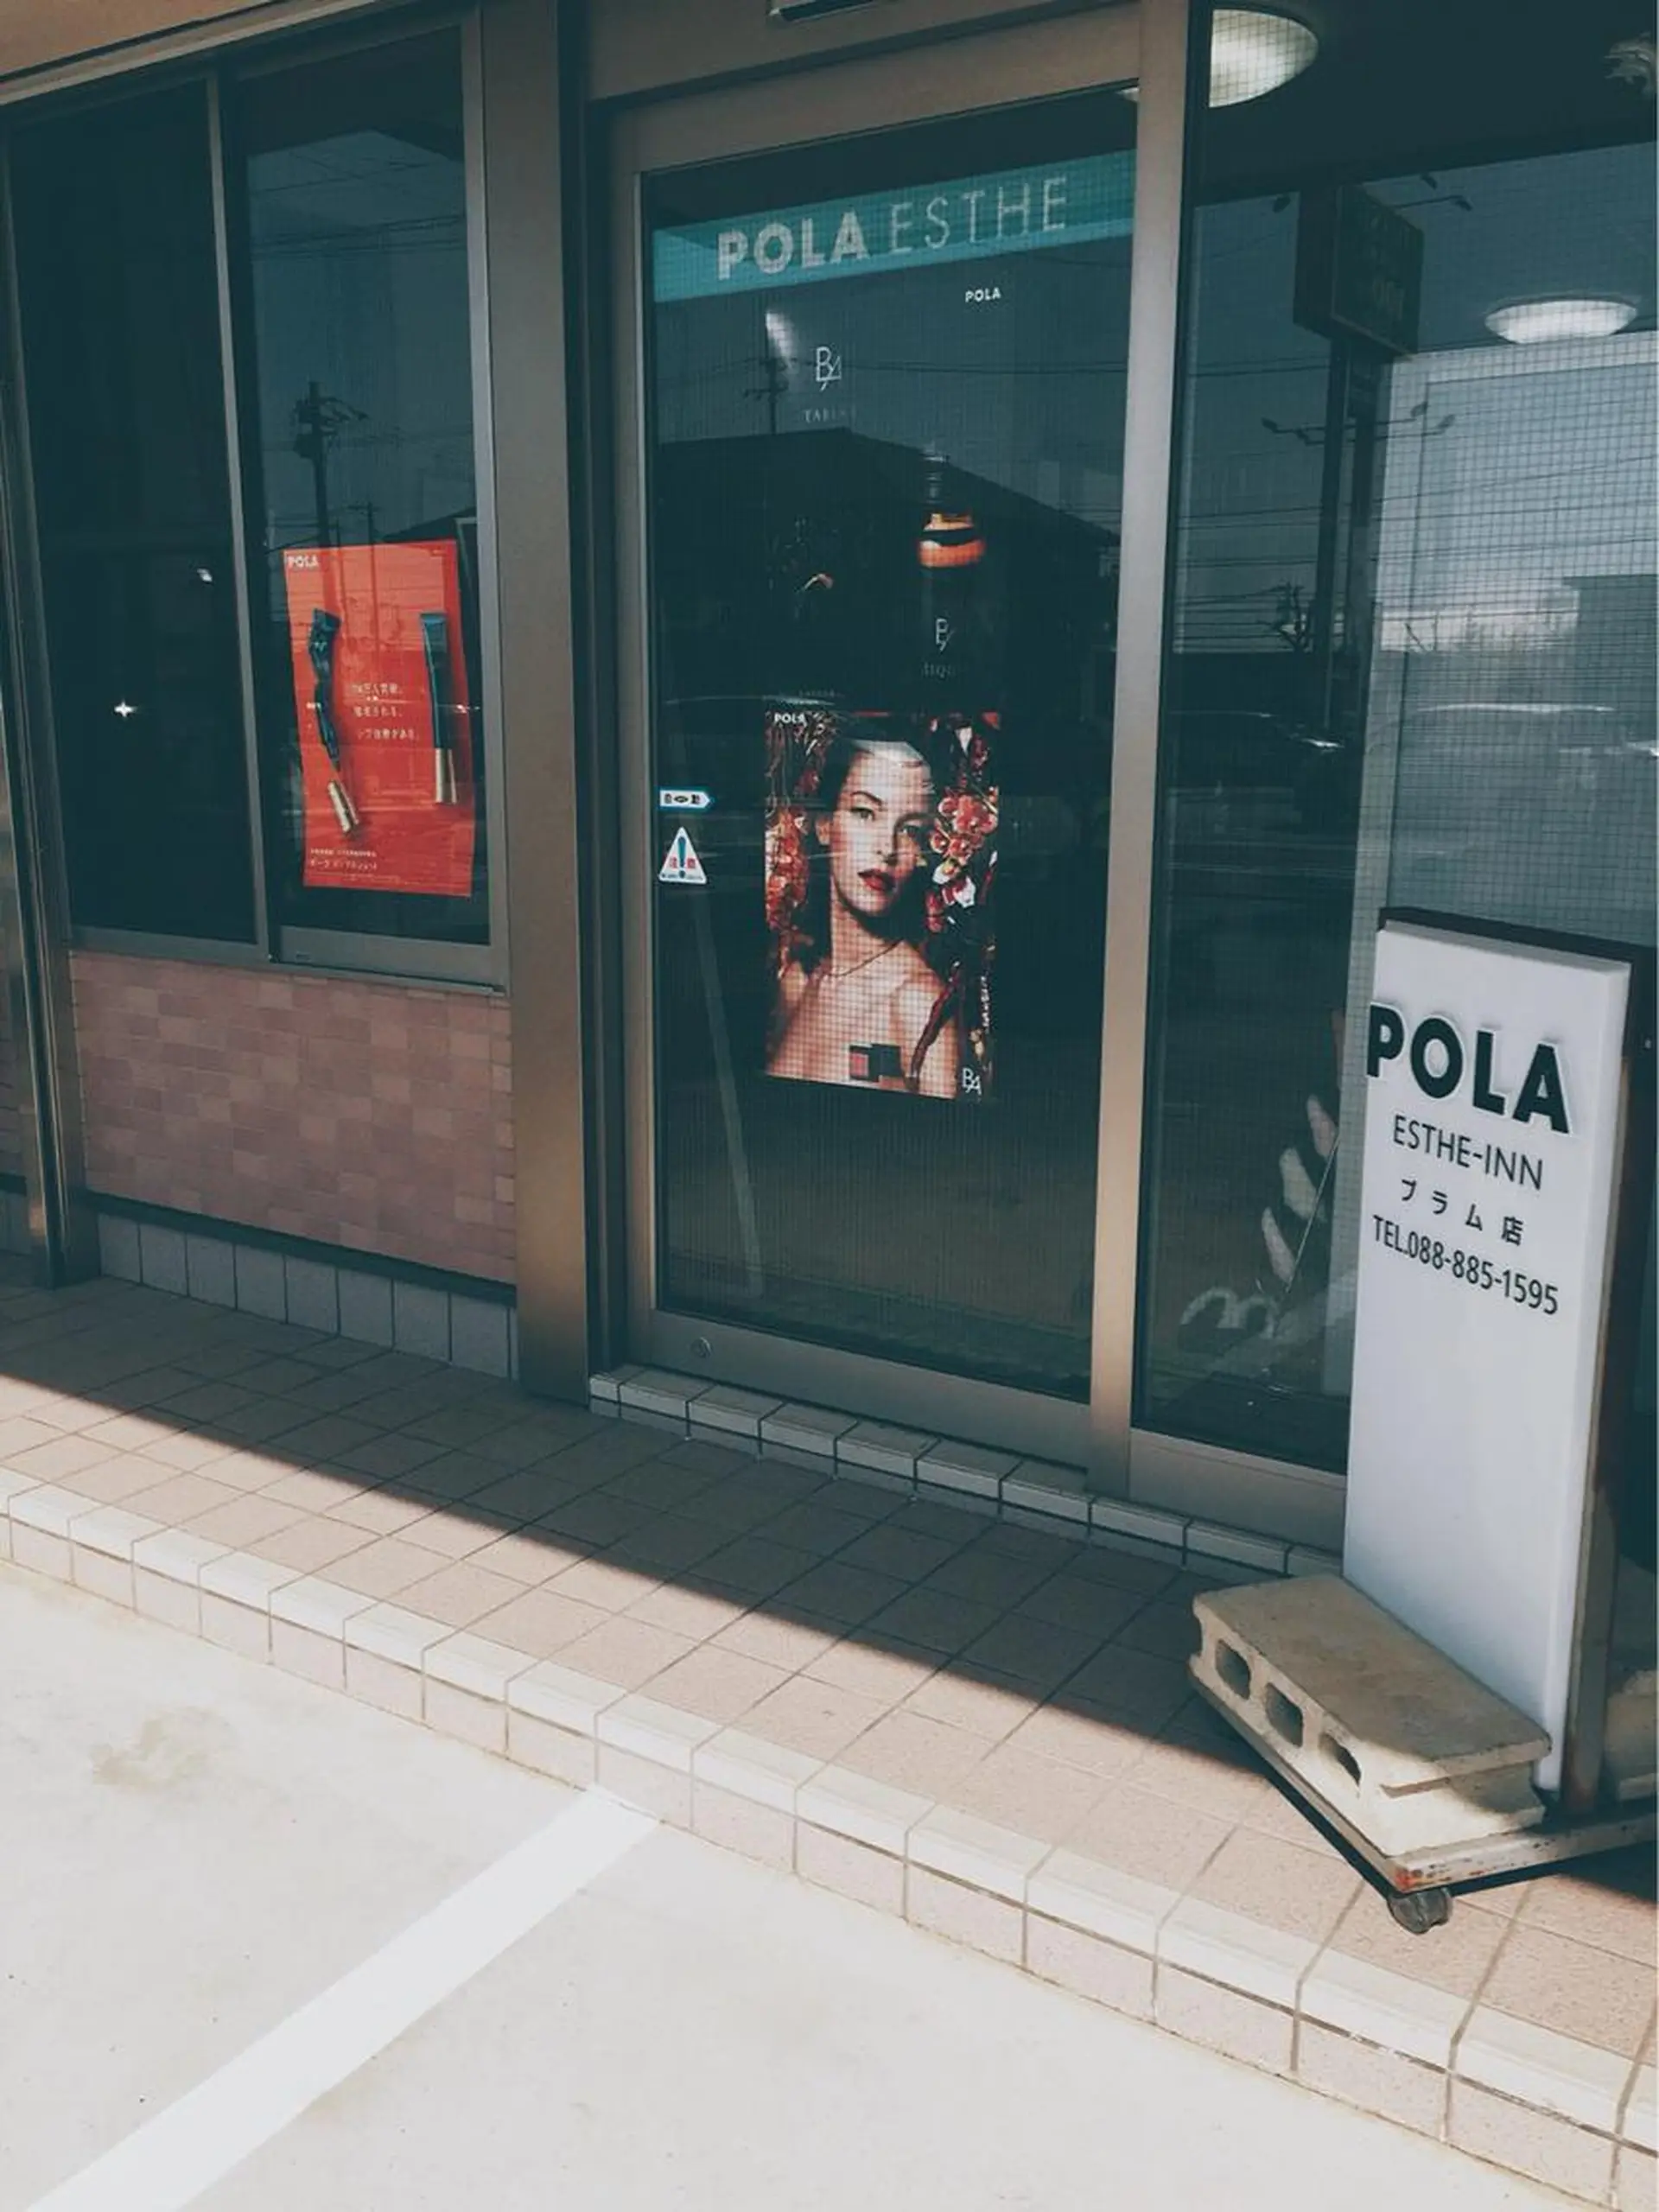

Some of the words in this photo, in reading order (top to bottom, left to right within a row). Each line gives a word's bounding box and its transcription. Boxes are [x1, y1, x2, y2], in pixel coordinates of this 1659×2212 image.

[718, 210, 869, 280] POLA
[890, 177, 1067, 253] ESTHE
[964, 286, 1002, 303] POLA
[773, 712, 807, 725] POLA
[1366, 1003, 1570, 1135] POLA
[1393, 1114, 1544, 1190] ESTHE-INN
[1373, 1214, 1560, 1316] TEL.088-885-1595
